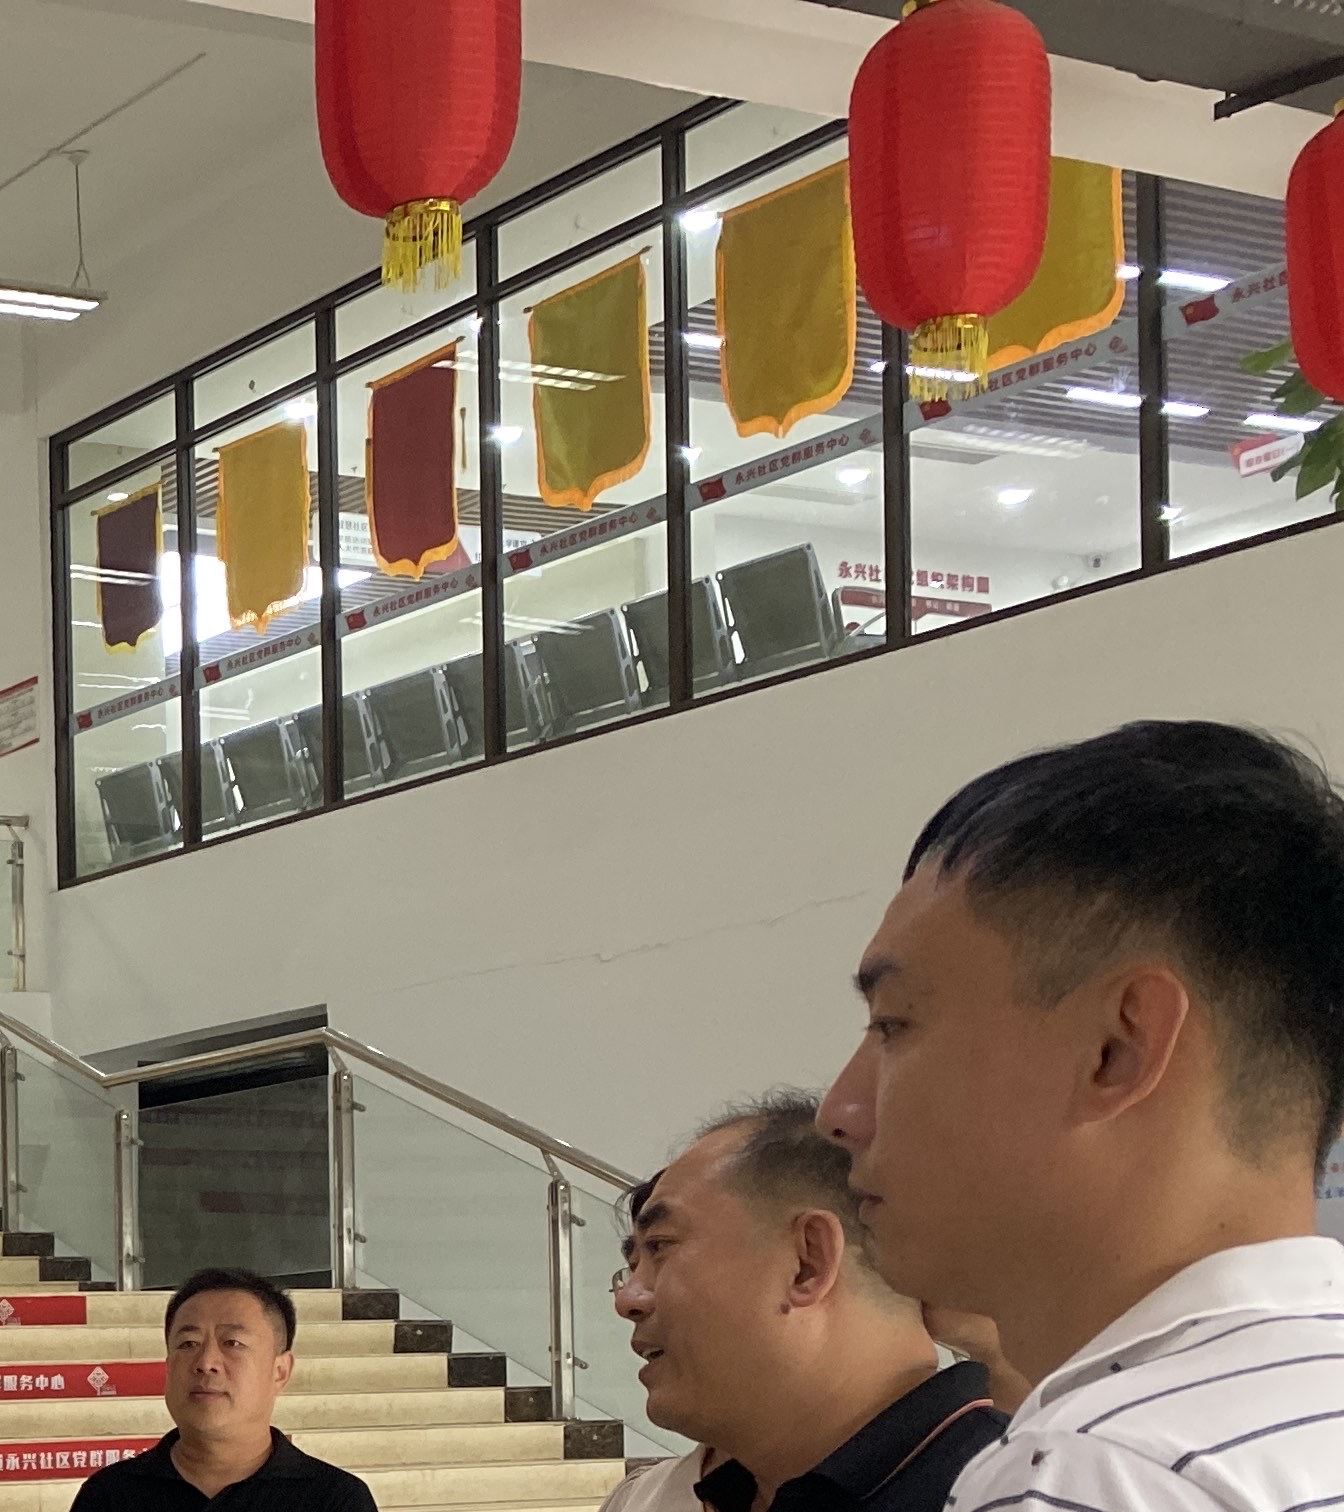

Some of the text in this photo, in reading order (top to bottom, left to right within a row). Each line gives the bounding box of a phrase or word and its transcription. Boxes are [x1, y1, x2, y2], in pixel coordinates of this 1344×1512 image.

[735, 434, 849, 485] 永兴社区党群服务中心
